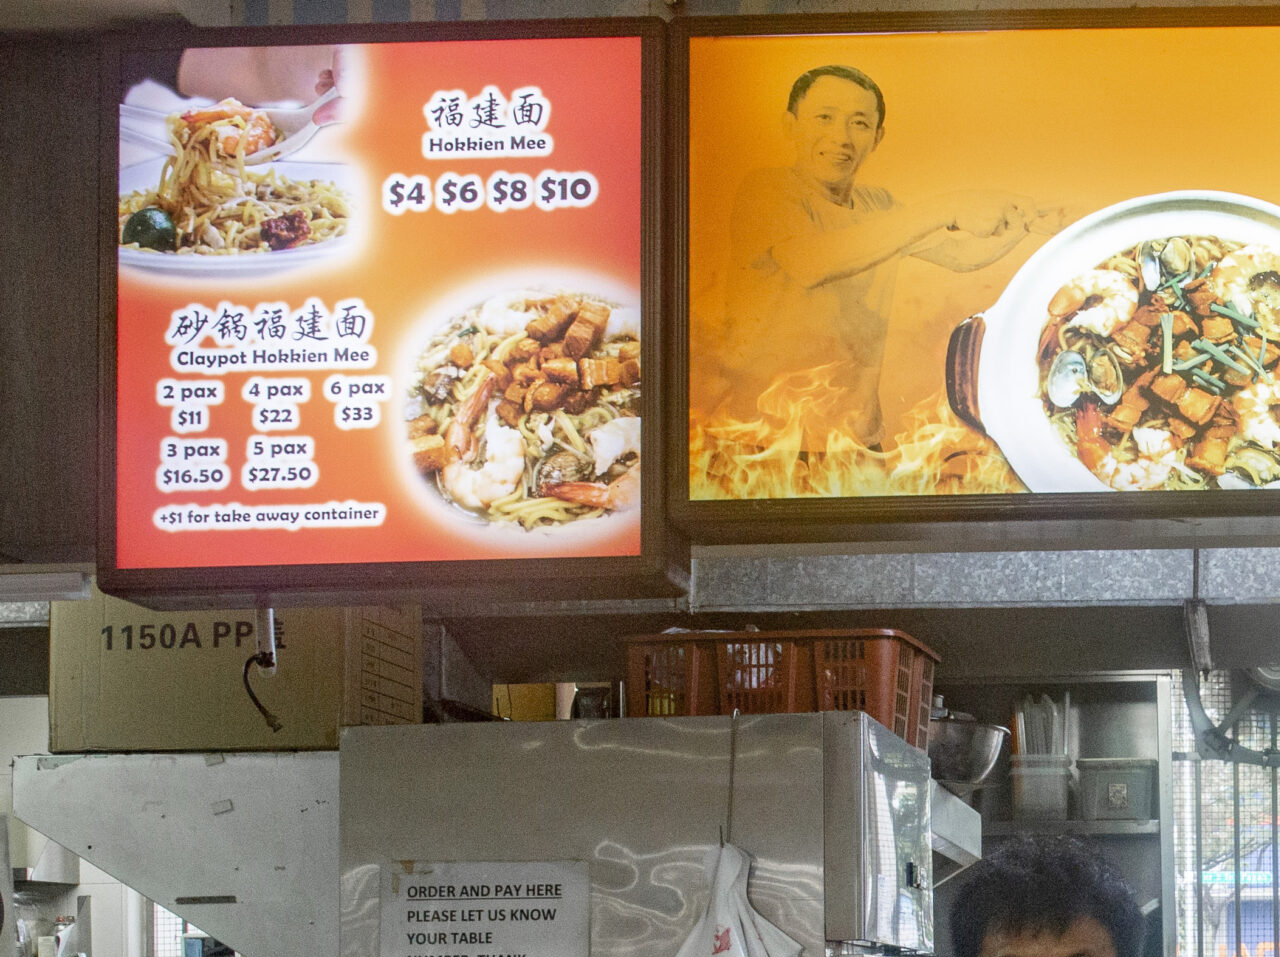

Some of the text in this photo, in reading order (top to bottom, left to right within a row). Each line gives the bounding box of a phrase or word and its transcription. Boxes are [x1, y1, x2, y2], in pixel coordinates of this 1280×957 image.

[431, 93, 544, 130] 福建面
[429, 136, 546, 153] Hokkien Mee
[389, 177, 592, 208] $4 $6 $8 $10
[172, 305, 367, 343] 砂锅福建面
[177, 348, 369, 368] Claypot Hokkien Mee
[163, 385, 217, 402] 2 pax
[248, 382, 302, 400] 4 pax
[330, 380, 385, 399] 6 pax
[178, 409, 202, 428] $11
[259, 408, 292, 426] $22
[342, 406, 373, 424] $33
[166, 443, 219, 461] 3 pax
[253, 441, 307, 459] 5 pax
[163, 466, 223, 486] $16.50
[248, 464, 310, 484] $27.50
[159, 507, 379, 527] +$1 for take away container
[102, 622, 201, 650] 1150A
[407, 884, 562, 898] ORDER AND PAY HERE
[407, 909, 556, 922] PLEASE LET US KNOW
[407, 932, 492, 944] YOUR TABLE
